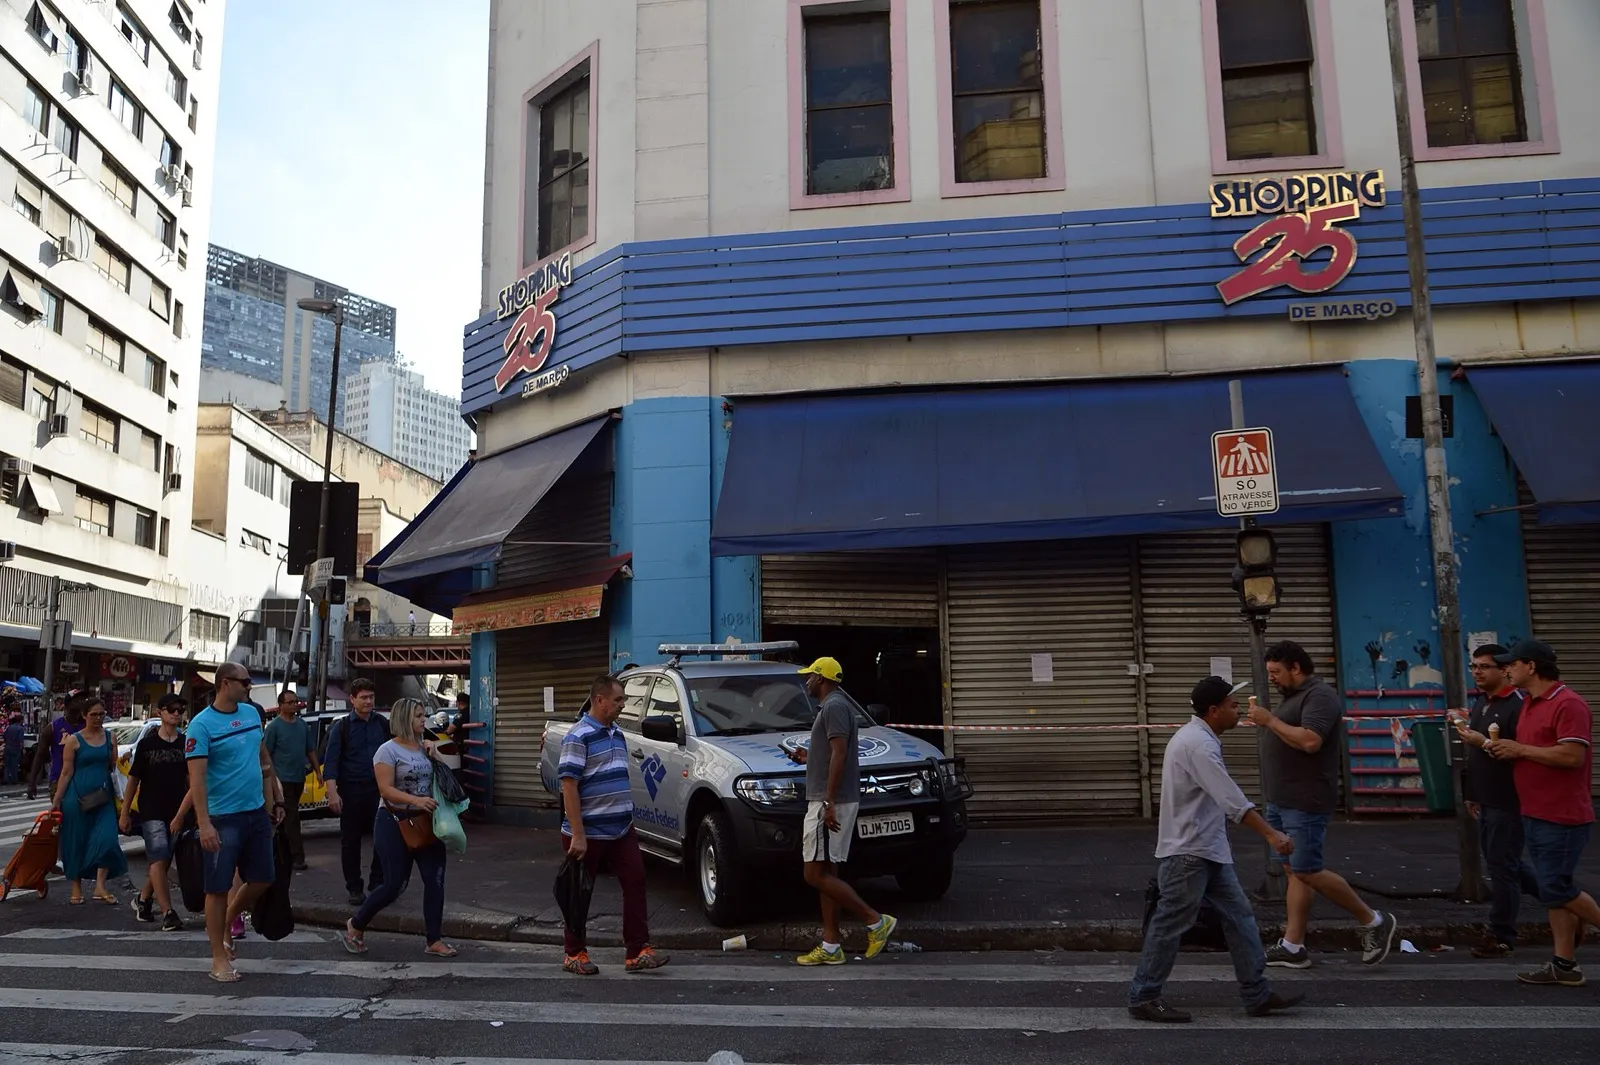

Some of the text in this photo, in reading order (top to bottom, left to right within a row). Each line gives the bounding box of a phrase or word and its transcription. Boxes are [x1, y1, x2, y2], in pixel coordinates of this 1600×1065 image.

[1211, 170, 1384, 215] SHOPPING
[1216, 199, 1359, 305] 25
[498, 251, 571, 319] SHOPPING
[1291, 302, 1394, 319] DE MARÇO
[494, 285, 558, 393] 25
[522, 366, 569, 395] DE MARÇO
[1222, 490, 1273, 501] ATRAVESSE
[1236, 477, 1257, 491] SÓ
[1224, 500, 1273, 510] NO VERDE
